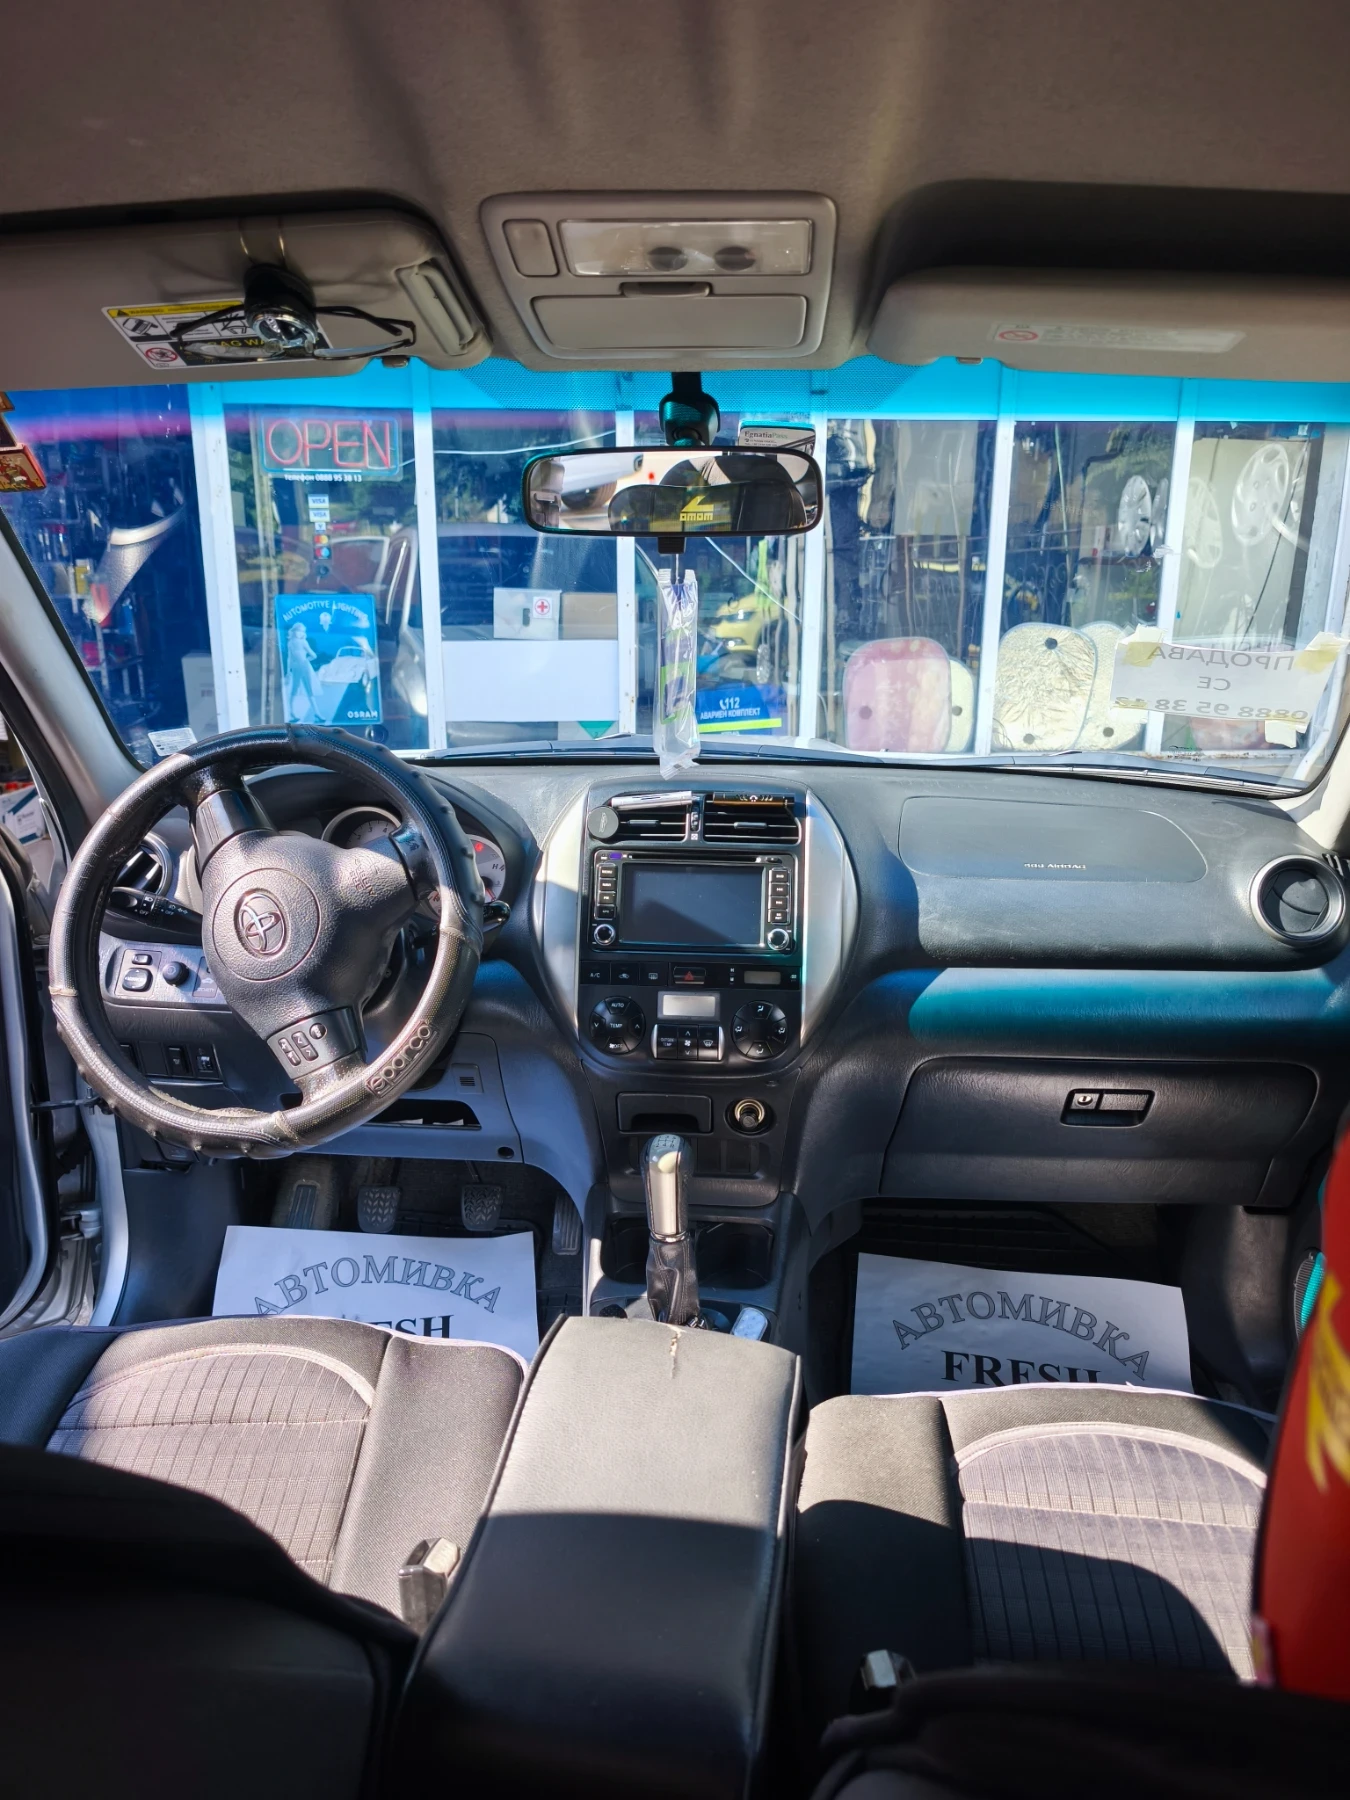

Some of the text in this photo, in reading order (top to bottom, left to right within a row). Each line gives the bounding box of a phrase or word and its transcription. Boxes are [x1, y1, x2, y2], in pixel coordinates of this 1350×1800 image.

[265, 418, 391, 468] OPEN
[282, 600, 330, 622] AUTOMOTIVE
[347, 710, 378, 719] OSRAM
[700, 707, 760, 720] АВАРИЕН КОМПЛЕКТ
[724, 697, 740, 709] 112
[367, 1024, 431, 1096] sparco
[254, 1254, 502, 1315] АВТОМИВКА
[892, 1290, 1151, 1381] АВТОМИВКА
